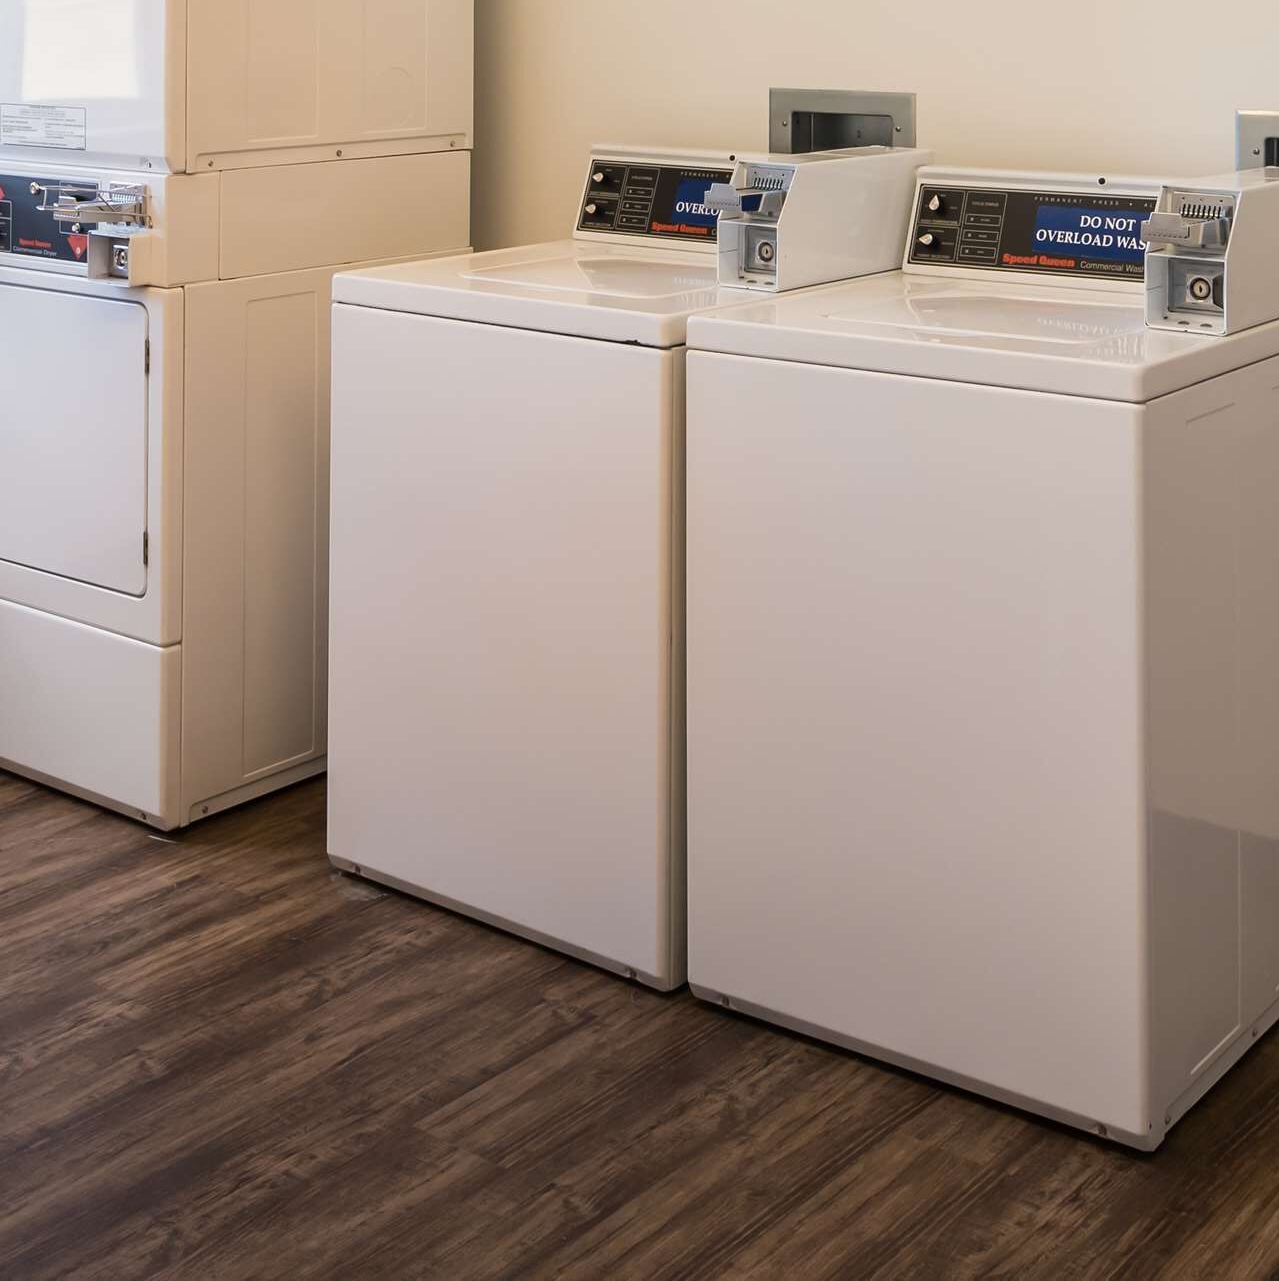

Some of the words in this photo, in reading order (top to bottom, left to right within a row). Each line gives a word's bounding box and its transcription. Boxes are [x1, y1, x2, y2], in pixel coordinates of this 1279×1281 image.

[1079, 215, 1102, 229] DO
[1104, 217, 1137, 232] NOT
[1035, 229, 1114, 248] OVERLOAD
[1002, 253, 1038, 265] Speed
[1039, 255, 1076, 268] Queen
[1080, 260, 1124, 272] Commercial
